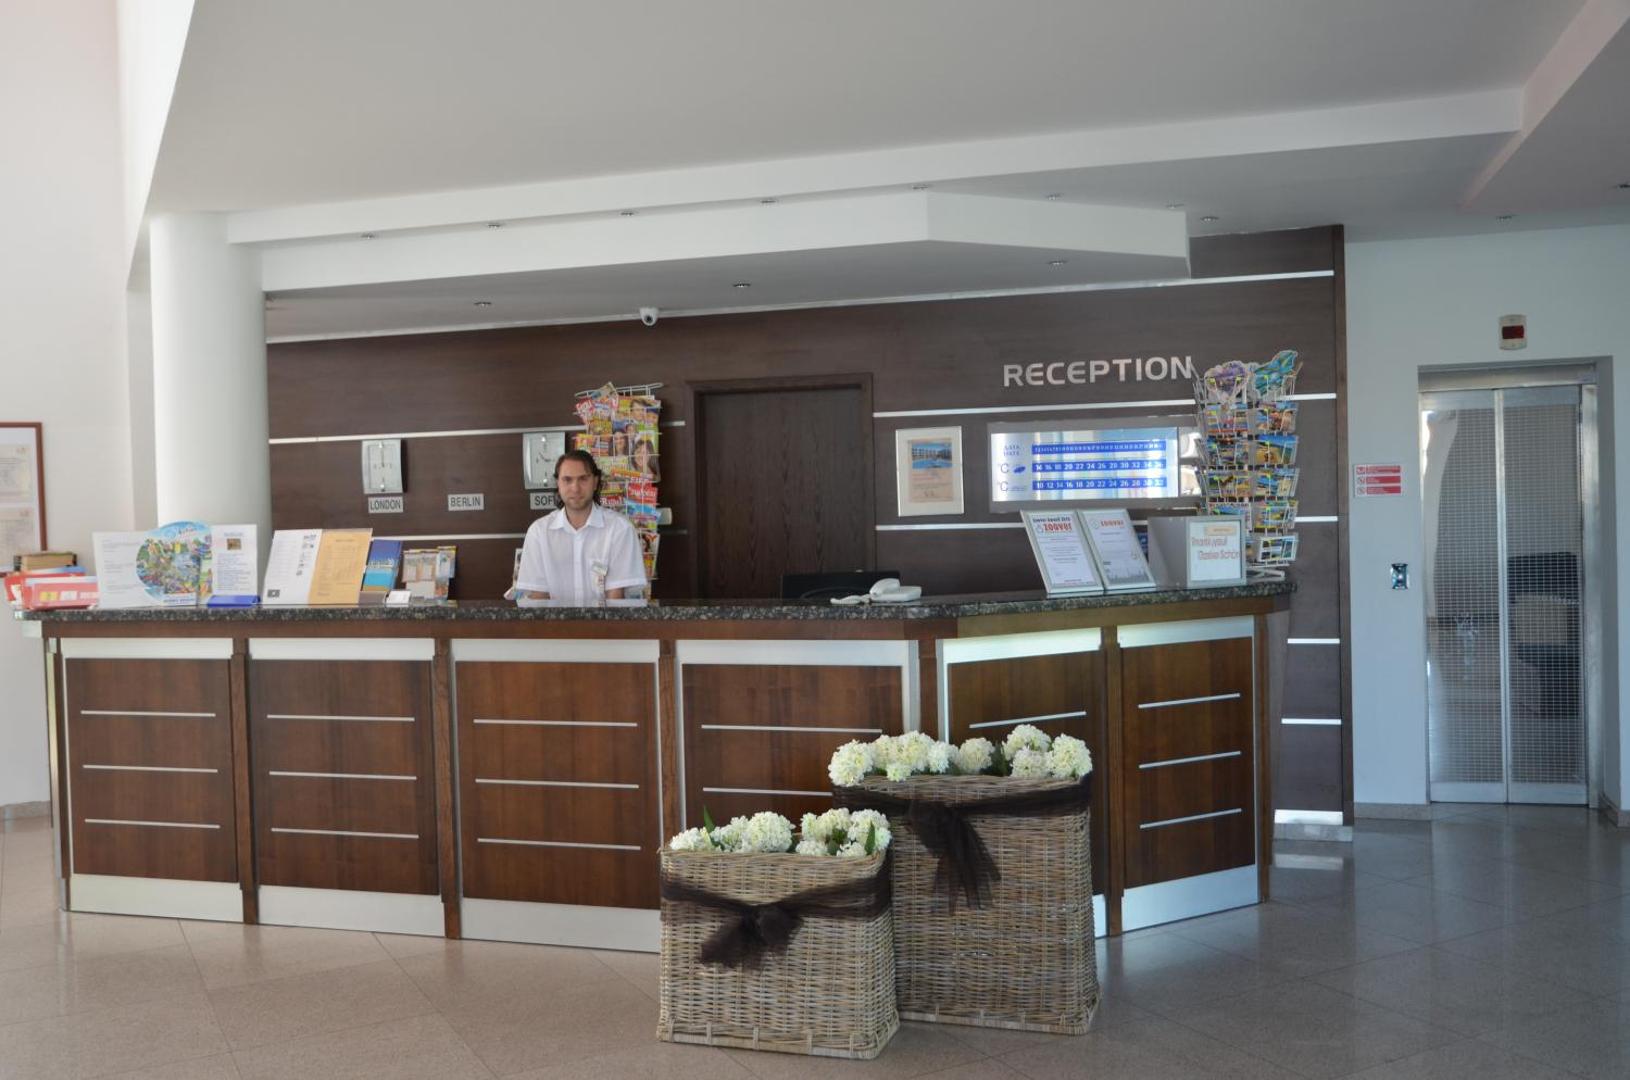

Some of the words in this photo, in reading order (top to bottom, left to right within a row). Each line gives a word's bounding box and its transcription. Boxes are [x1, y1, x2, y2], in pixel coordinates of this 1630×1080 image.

[1003, 356, 1192, 387] RECEPTION
[370, 500, 401, 510] LONDON
[450, 496, 481, 507] BERLIN
[534, 495, 558, 506] SOFI
